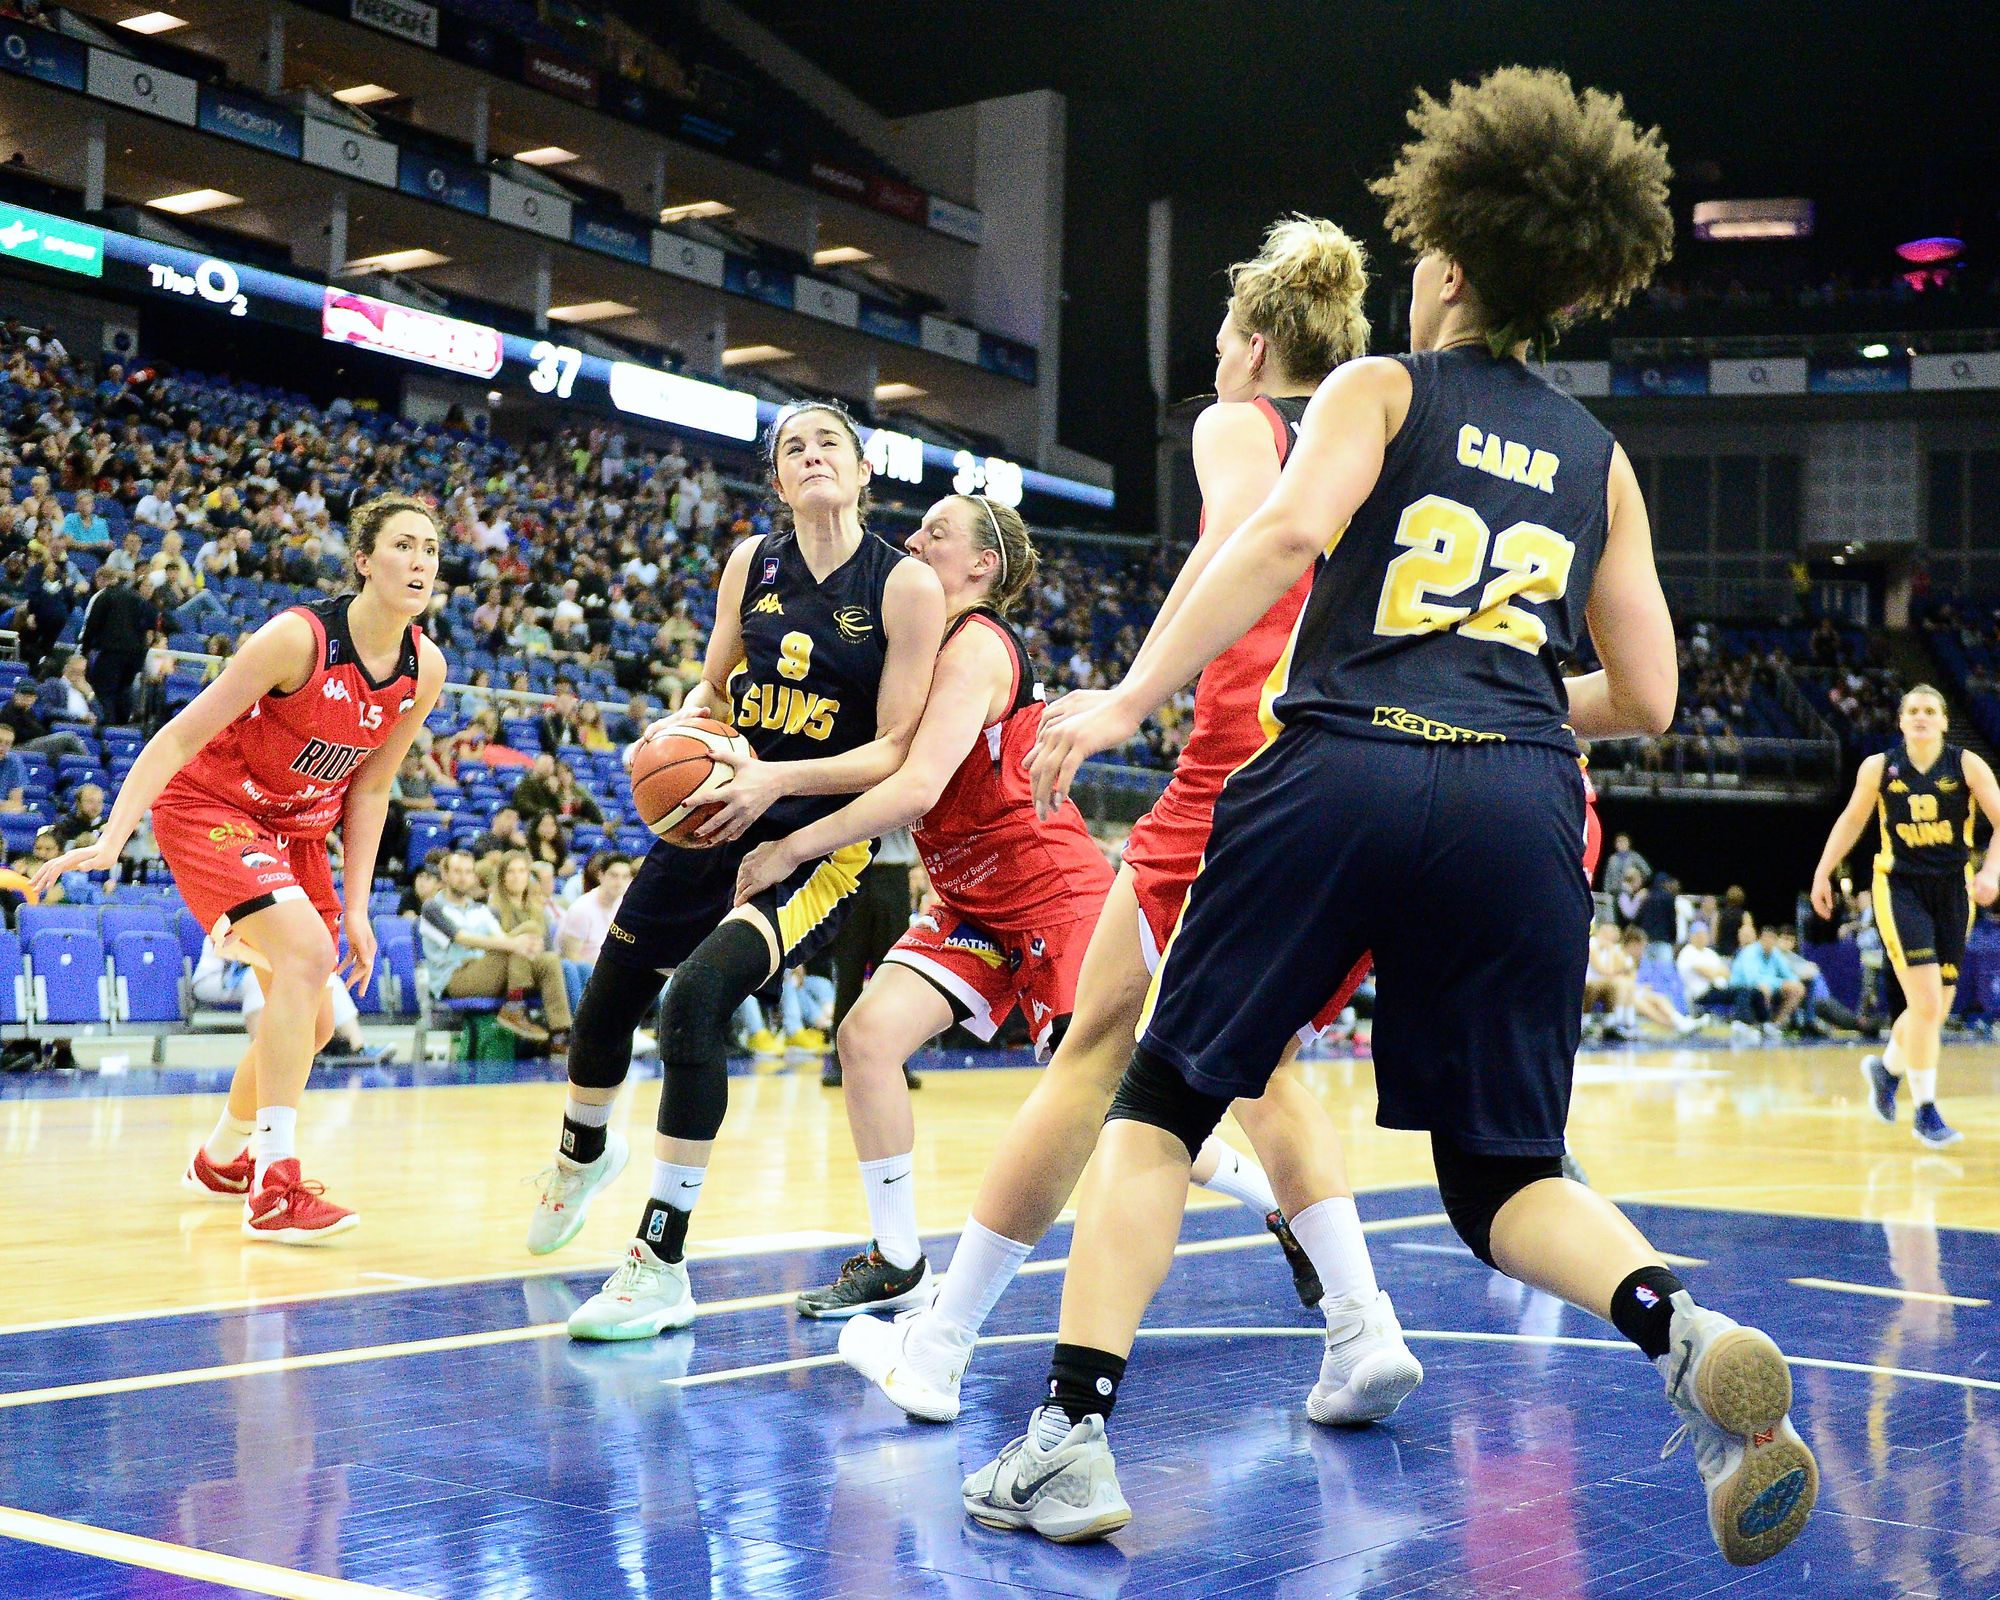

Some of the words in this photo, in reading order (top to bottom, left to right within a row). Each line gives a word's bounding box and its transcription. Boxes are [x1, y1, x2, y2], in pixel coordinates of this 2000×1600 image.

[148, 263, 198, 295] The
[194, 259, 248, 317] O2
[529, 340, 582, 398] 37
[1457, 424, 1559, 494] CARR
[1373, 494, 1576, 656] 22
[777, 631, 814, 681] 9
[358, 701, 384, 730] 15
[737, 683, 840, 741] SUNS
[289, 736, 375, 783] RIDE
[242, 780, 263, 801] Red
[960, 865, 998, 891] Economics
[969, 851, 999, 876] Business
